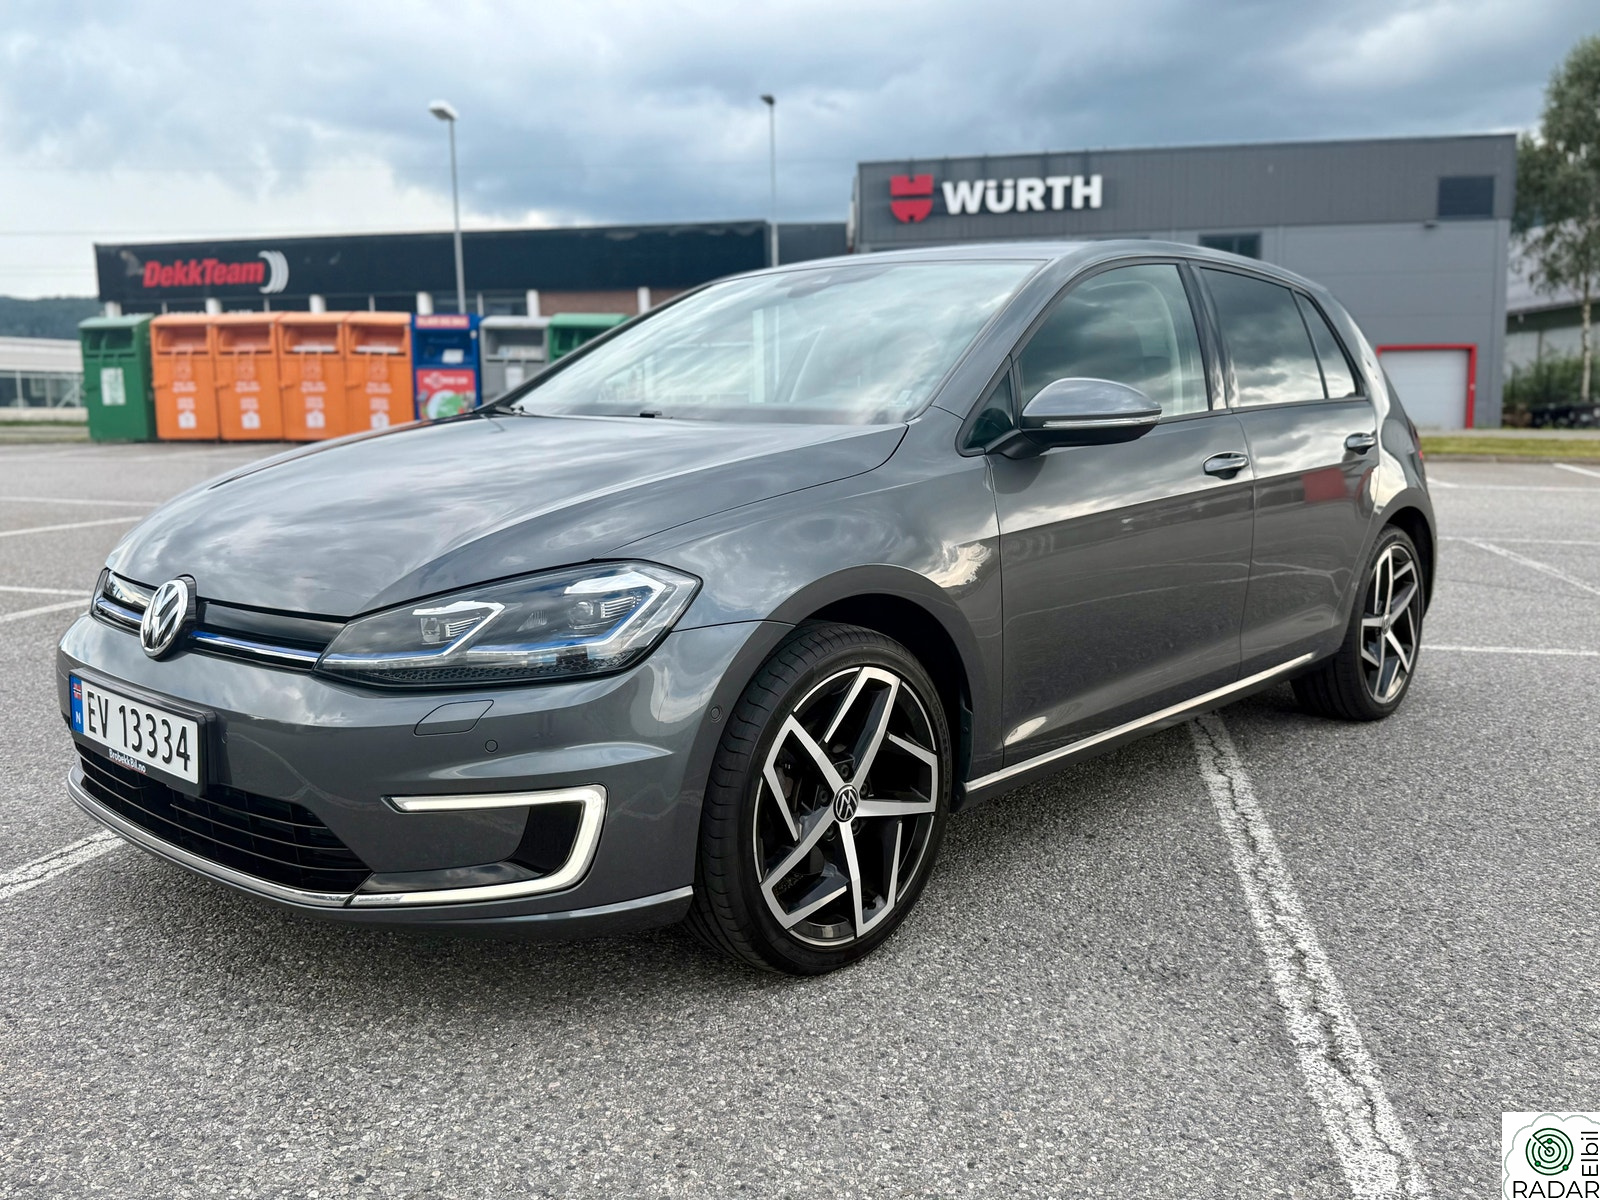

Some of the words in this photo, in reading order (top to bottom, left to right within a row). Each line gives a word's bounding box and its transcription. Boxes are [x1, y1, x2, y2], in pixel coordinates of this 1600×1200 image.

[941, 174, 1103, 215] WÜRTH
[143, 258, 266, 288] DekkTeam
[75, 710, 82, 725] N
[87, 690, 109, 739] EV
[118, 704, 191, 772] 13334
